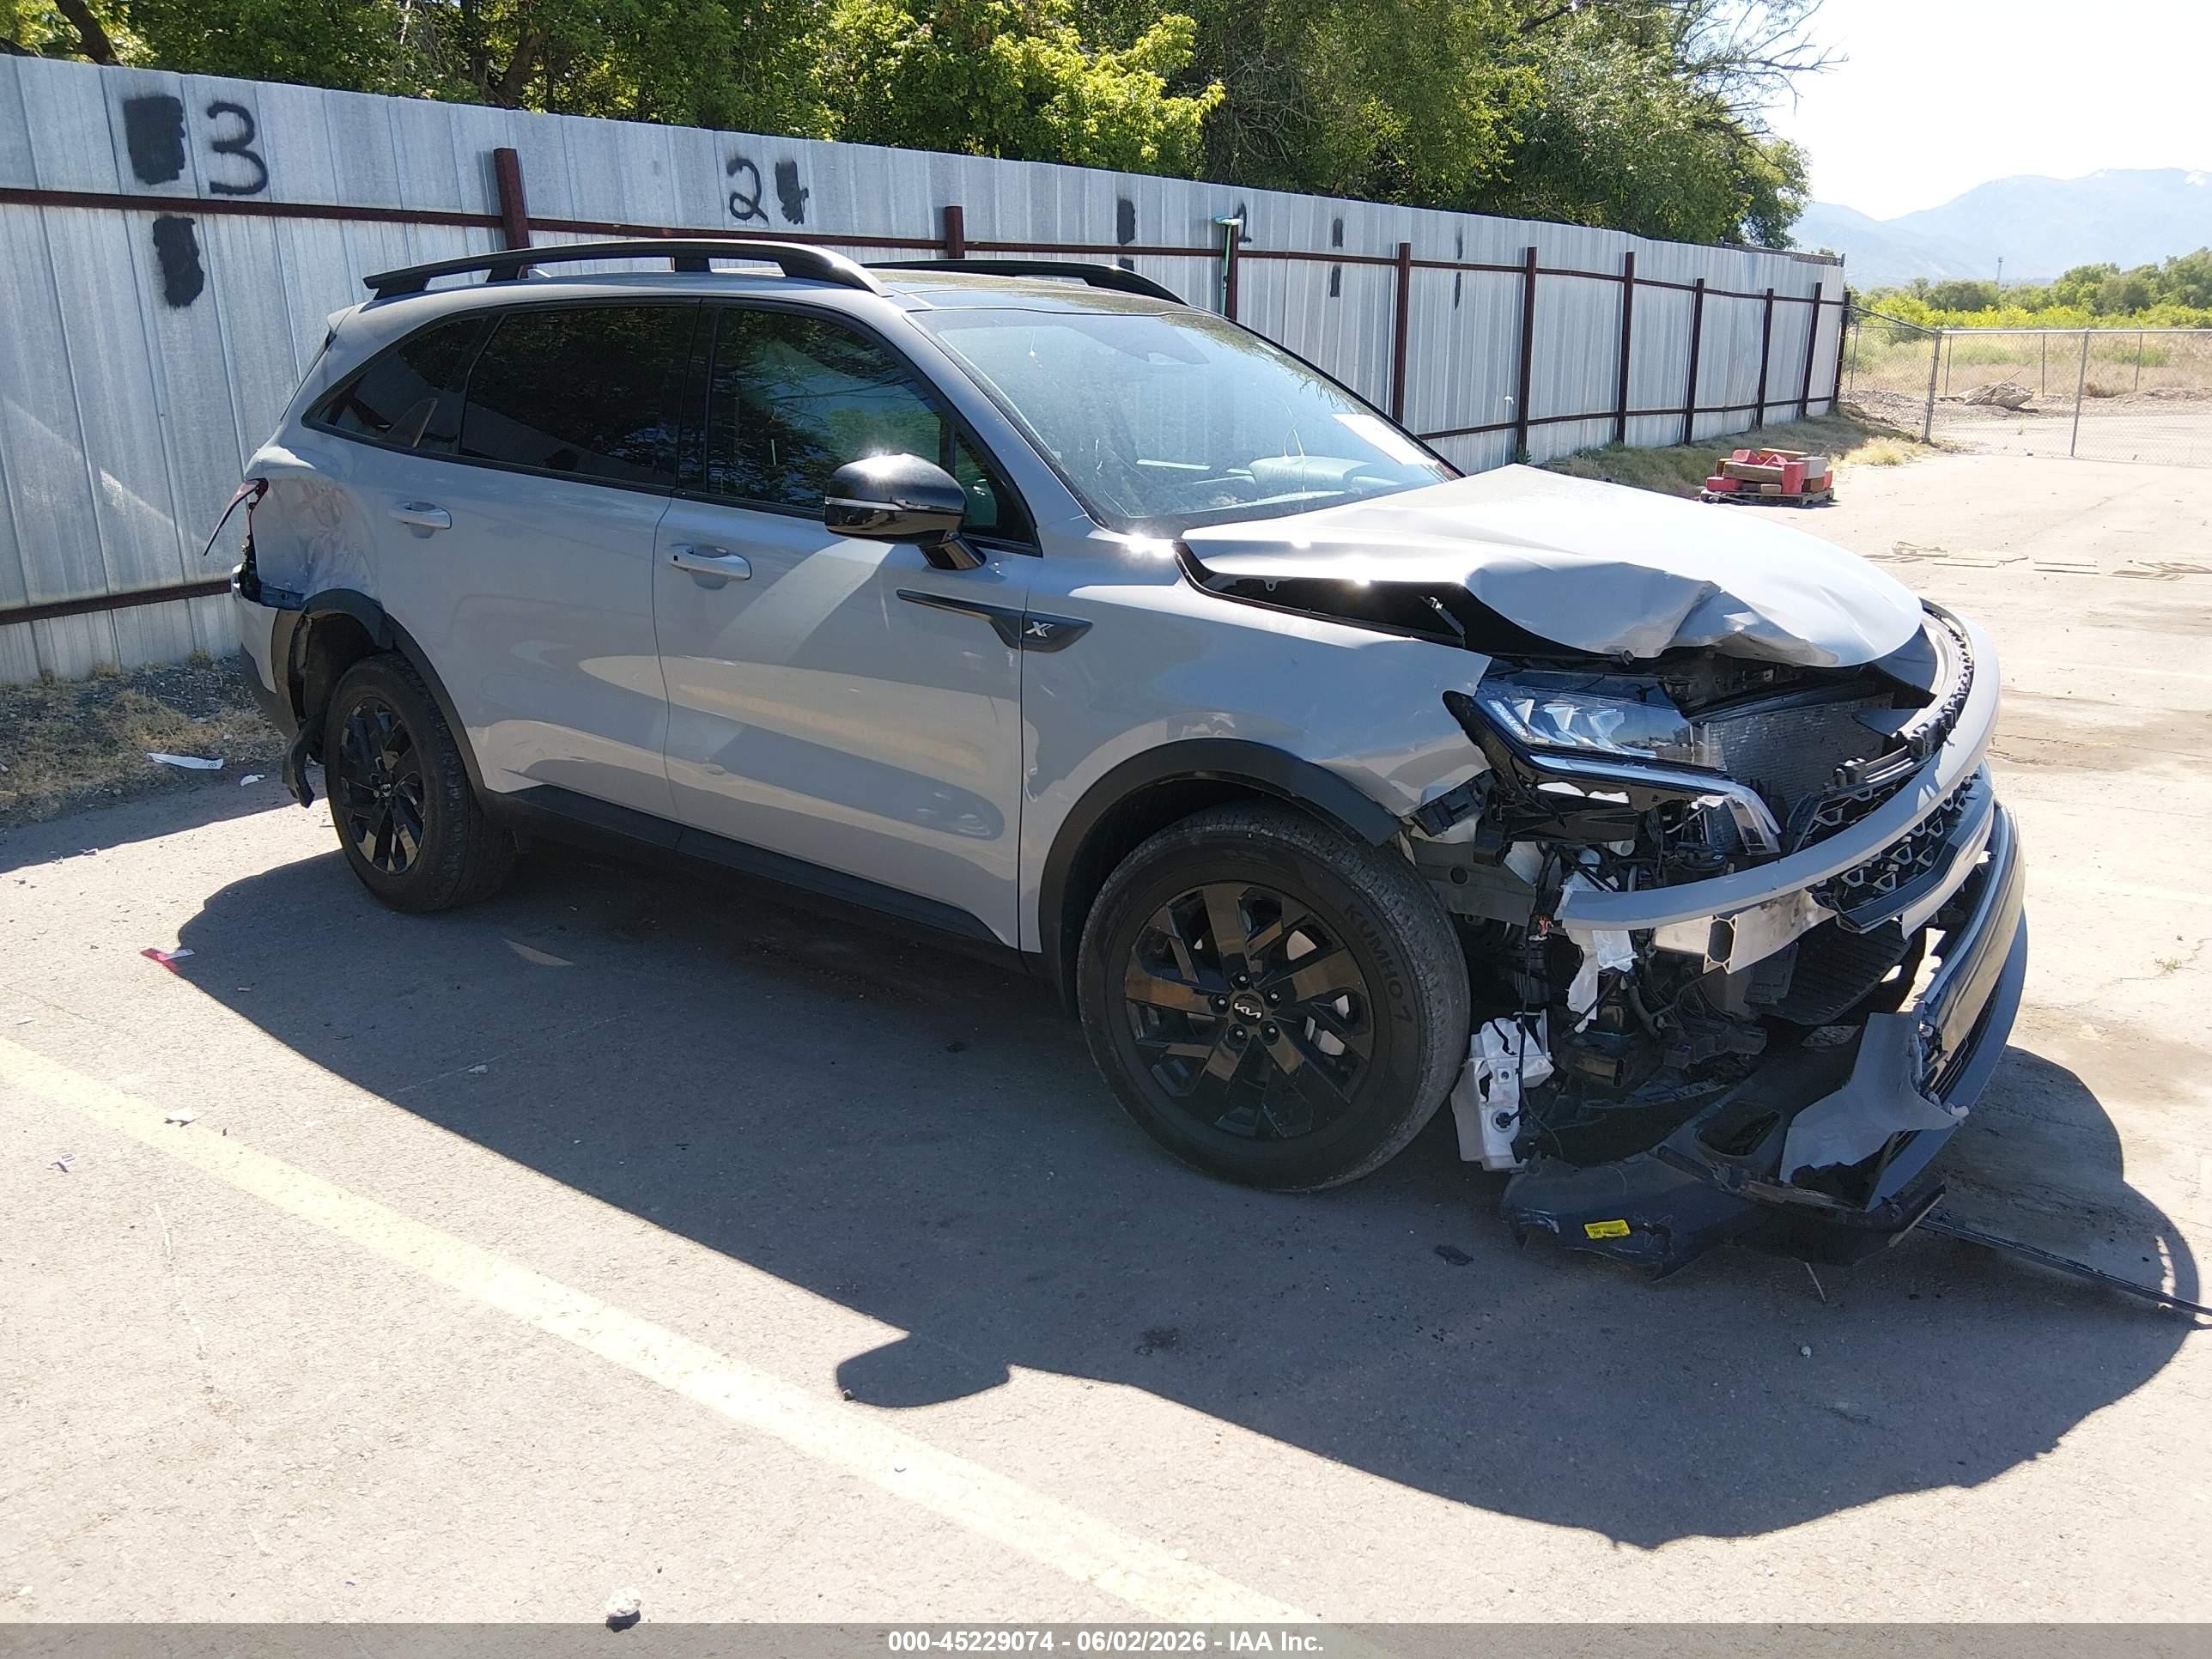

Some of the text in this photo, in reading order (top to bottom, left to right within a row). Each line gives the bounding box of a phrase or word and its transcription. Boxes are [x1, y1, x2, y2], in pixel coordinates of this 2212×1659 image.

[207, 100, 270, 196] 3
[726, 157, 769, 225] 2
[1342, 903, 1404, 1000] KUMHO
